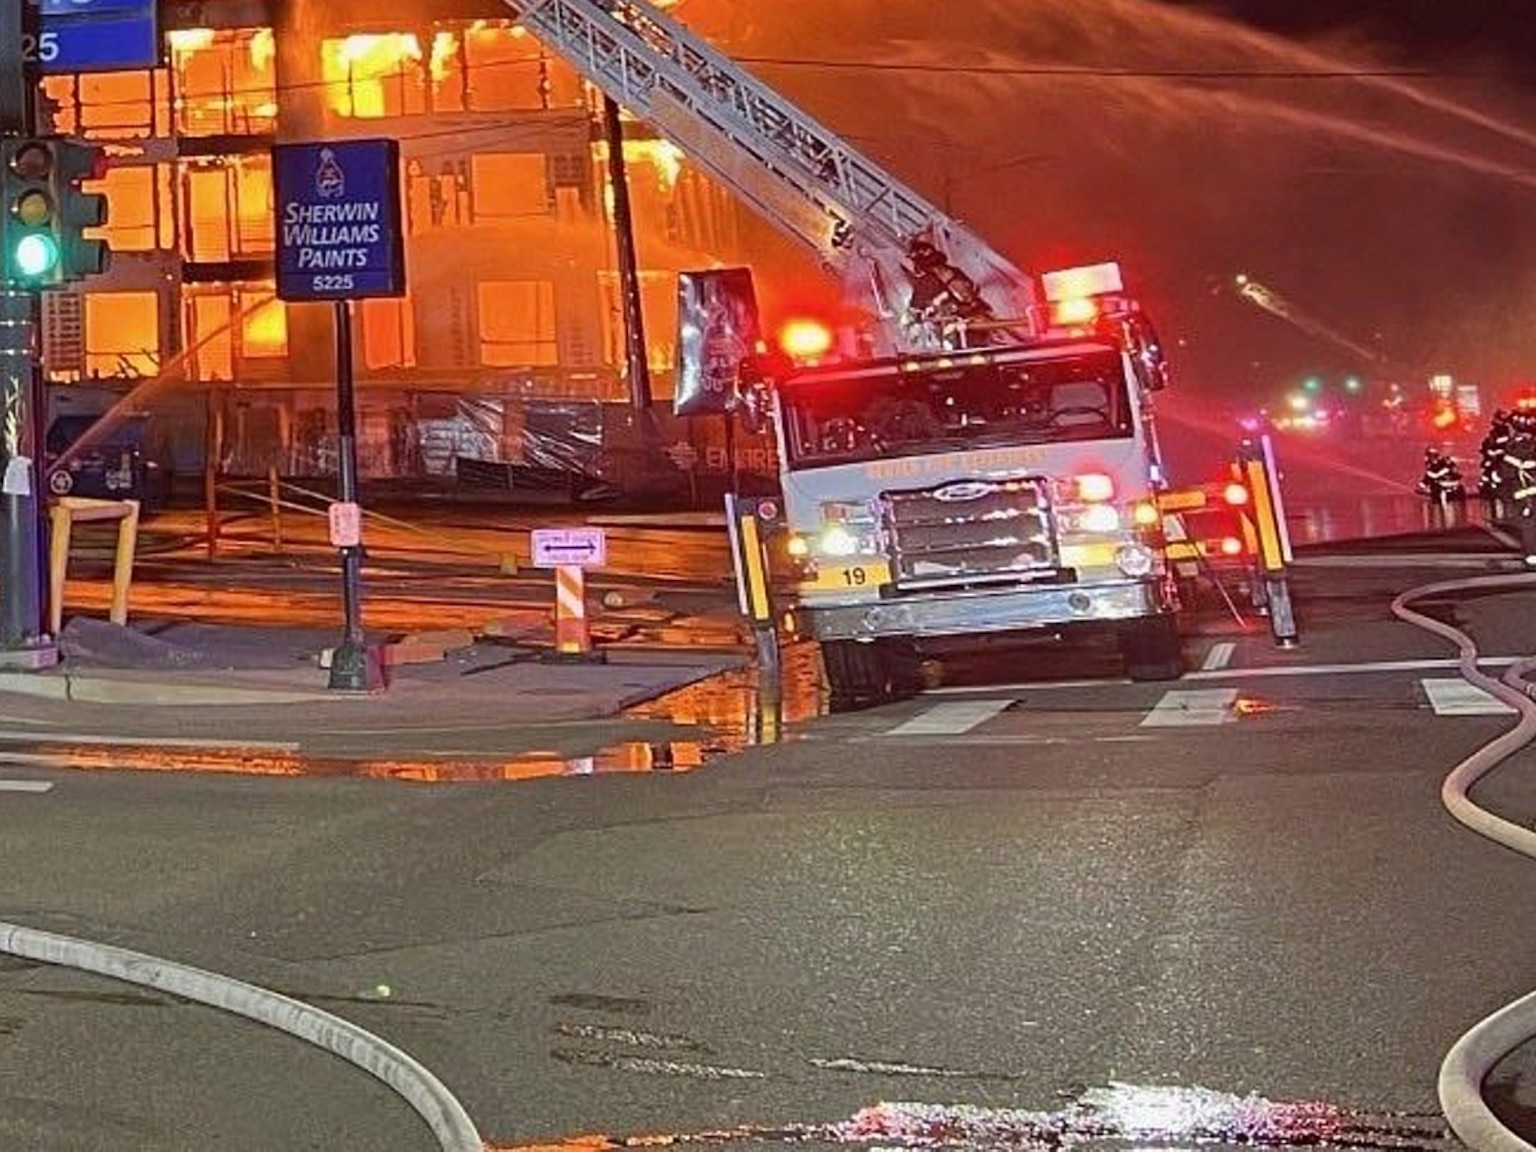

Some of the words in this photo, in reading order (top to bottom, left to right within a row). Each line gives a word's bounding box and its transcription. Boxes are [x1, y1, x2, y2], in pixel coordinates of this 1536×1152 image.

[284, 202, 378, 224] SHERWIN
[283, 224, 381, 247] WILLIAMS
[298, 248, 367, 268] PAINTS
[313, 274, 354, 291] 5225
[843, 566, 866, 586] 19
